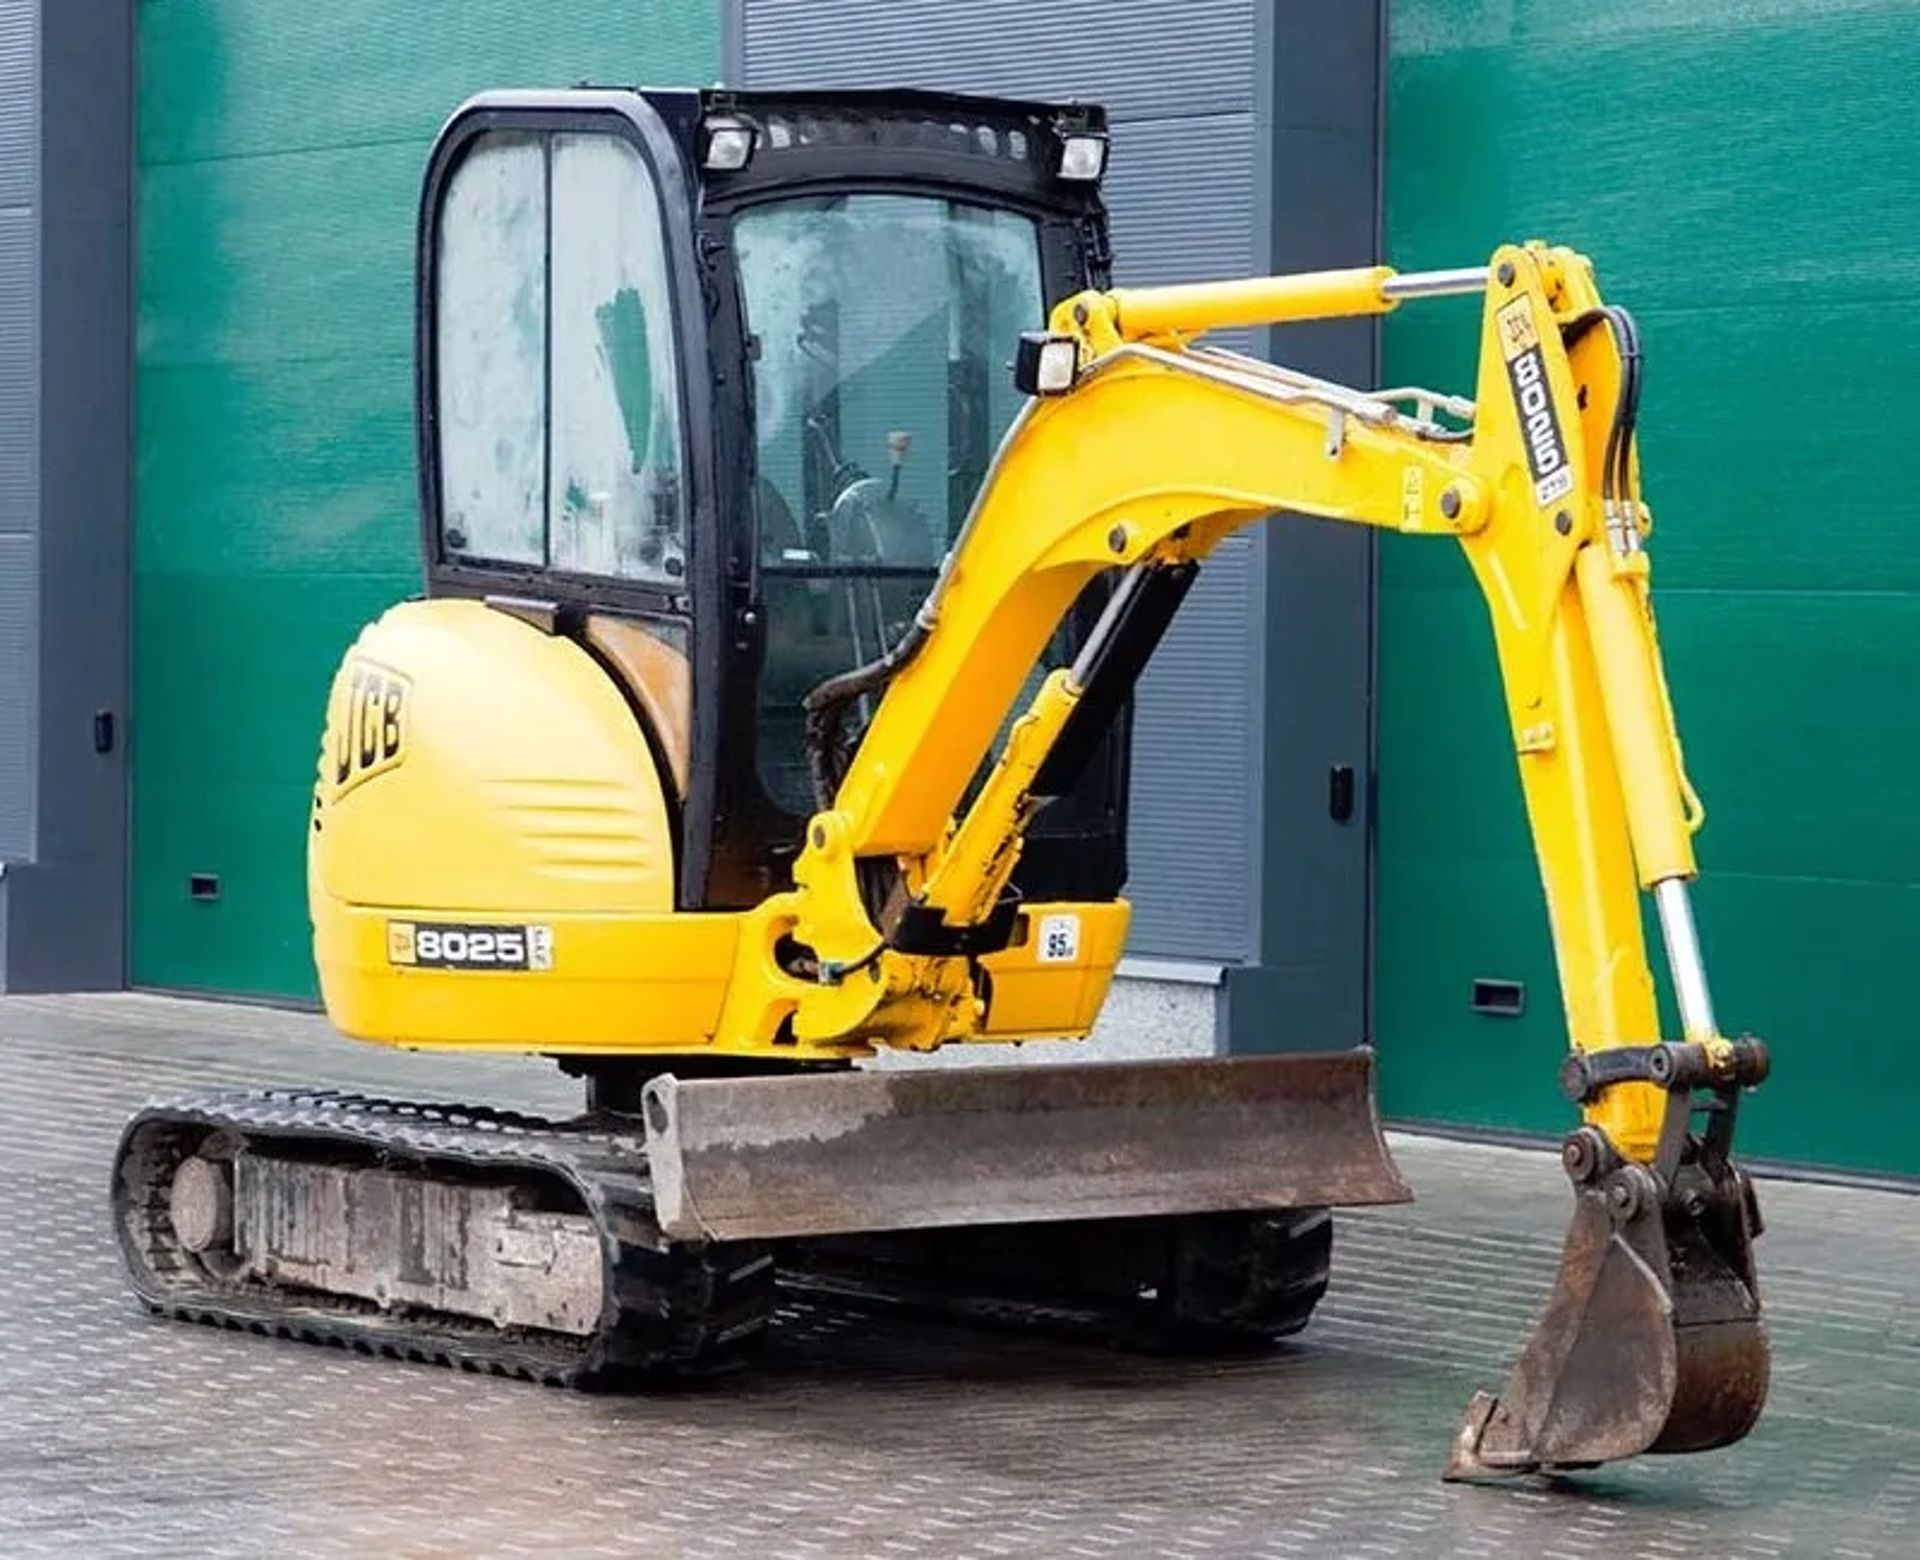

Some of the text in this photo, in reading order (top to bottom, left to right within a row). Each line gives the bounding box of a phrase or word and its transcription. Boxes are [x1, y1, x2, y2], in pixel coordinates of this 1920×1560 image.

[1513, 352, 1560, 475] 8025
[336, 664, 402, 784] JCB
[417, 930, 525, 961] 8025
